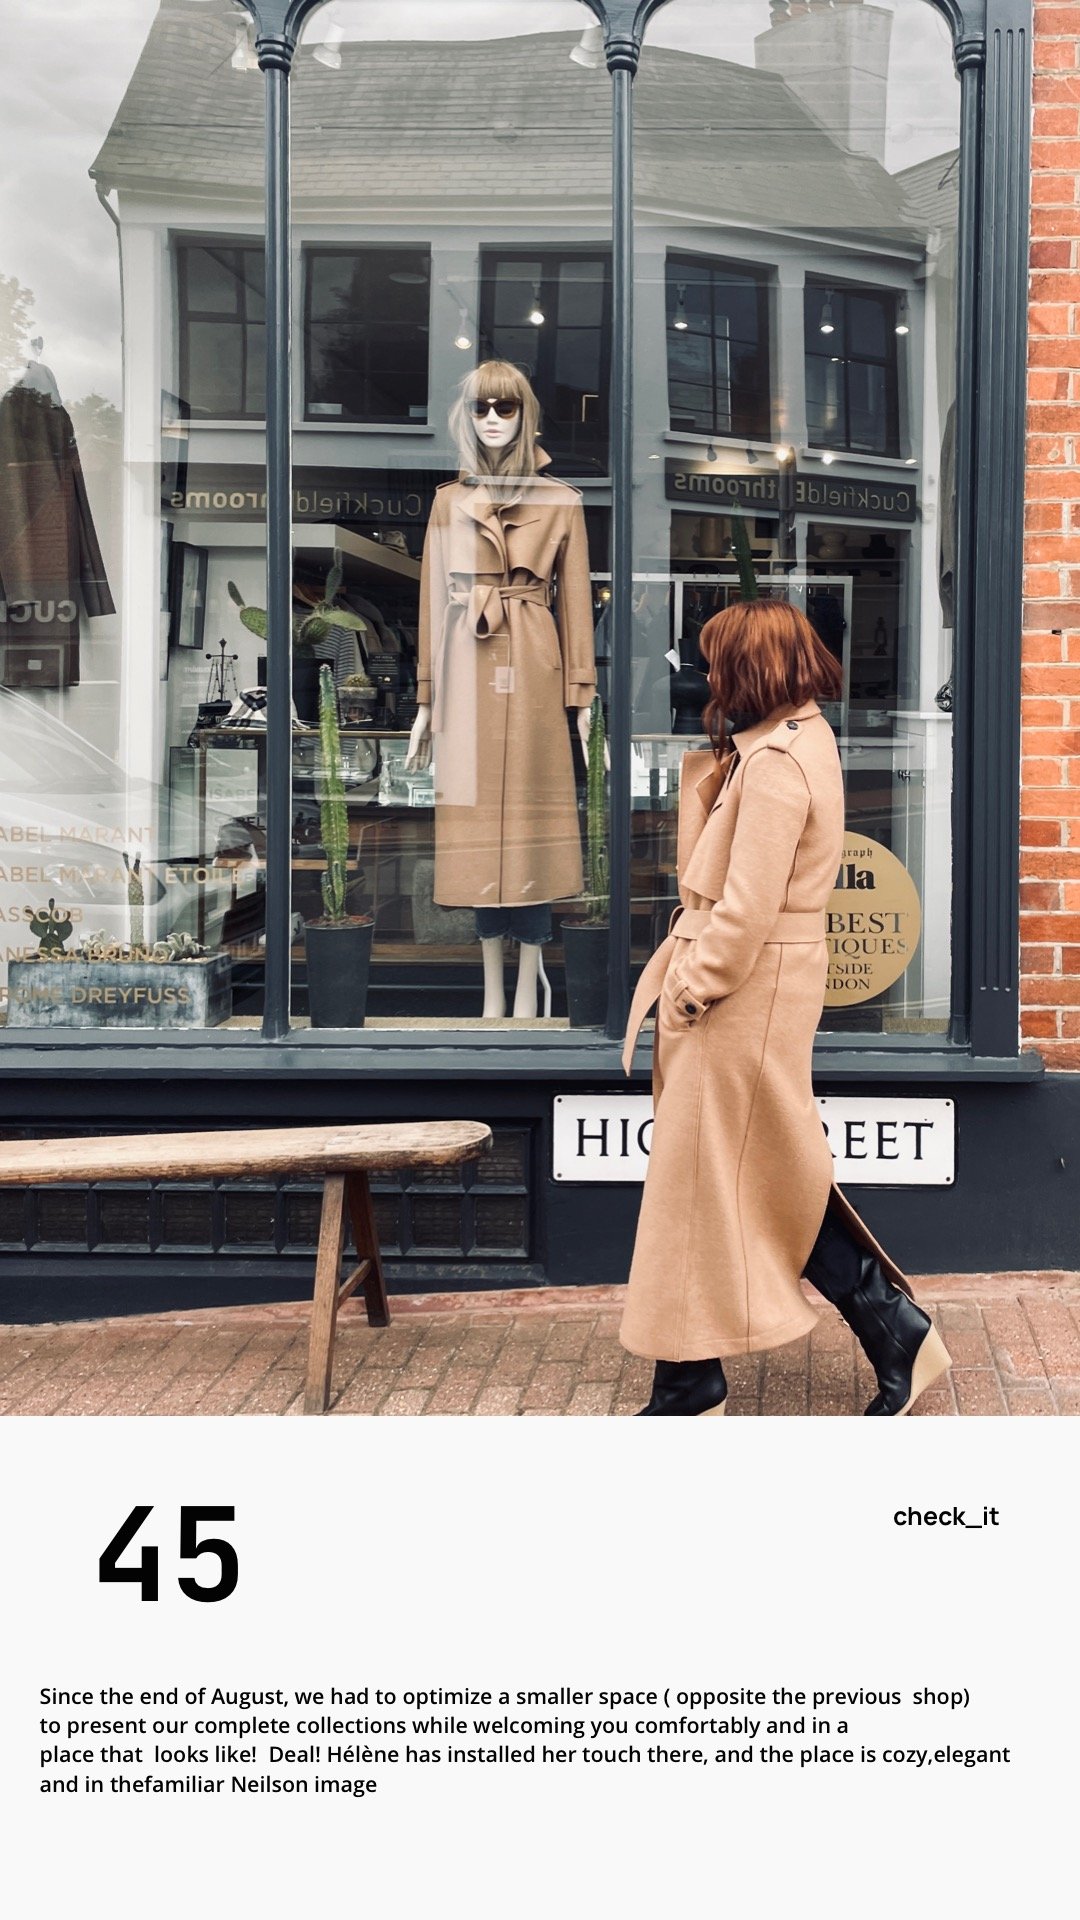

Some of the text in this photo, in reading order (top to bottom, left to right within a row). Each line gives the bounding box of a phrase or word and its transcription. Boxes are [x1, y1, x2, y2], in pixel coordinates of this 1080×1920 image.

[60, 826, 155, 842] MARANT
[60, 867, 153, 883] MARANT
[165, 867, 245, 884] ETOILE
[826, 912, 909, 934] BEST
[88, 946, 169, 963] BRUNO
[72, 987, 190, 1004] DREYFUSS
